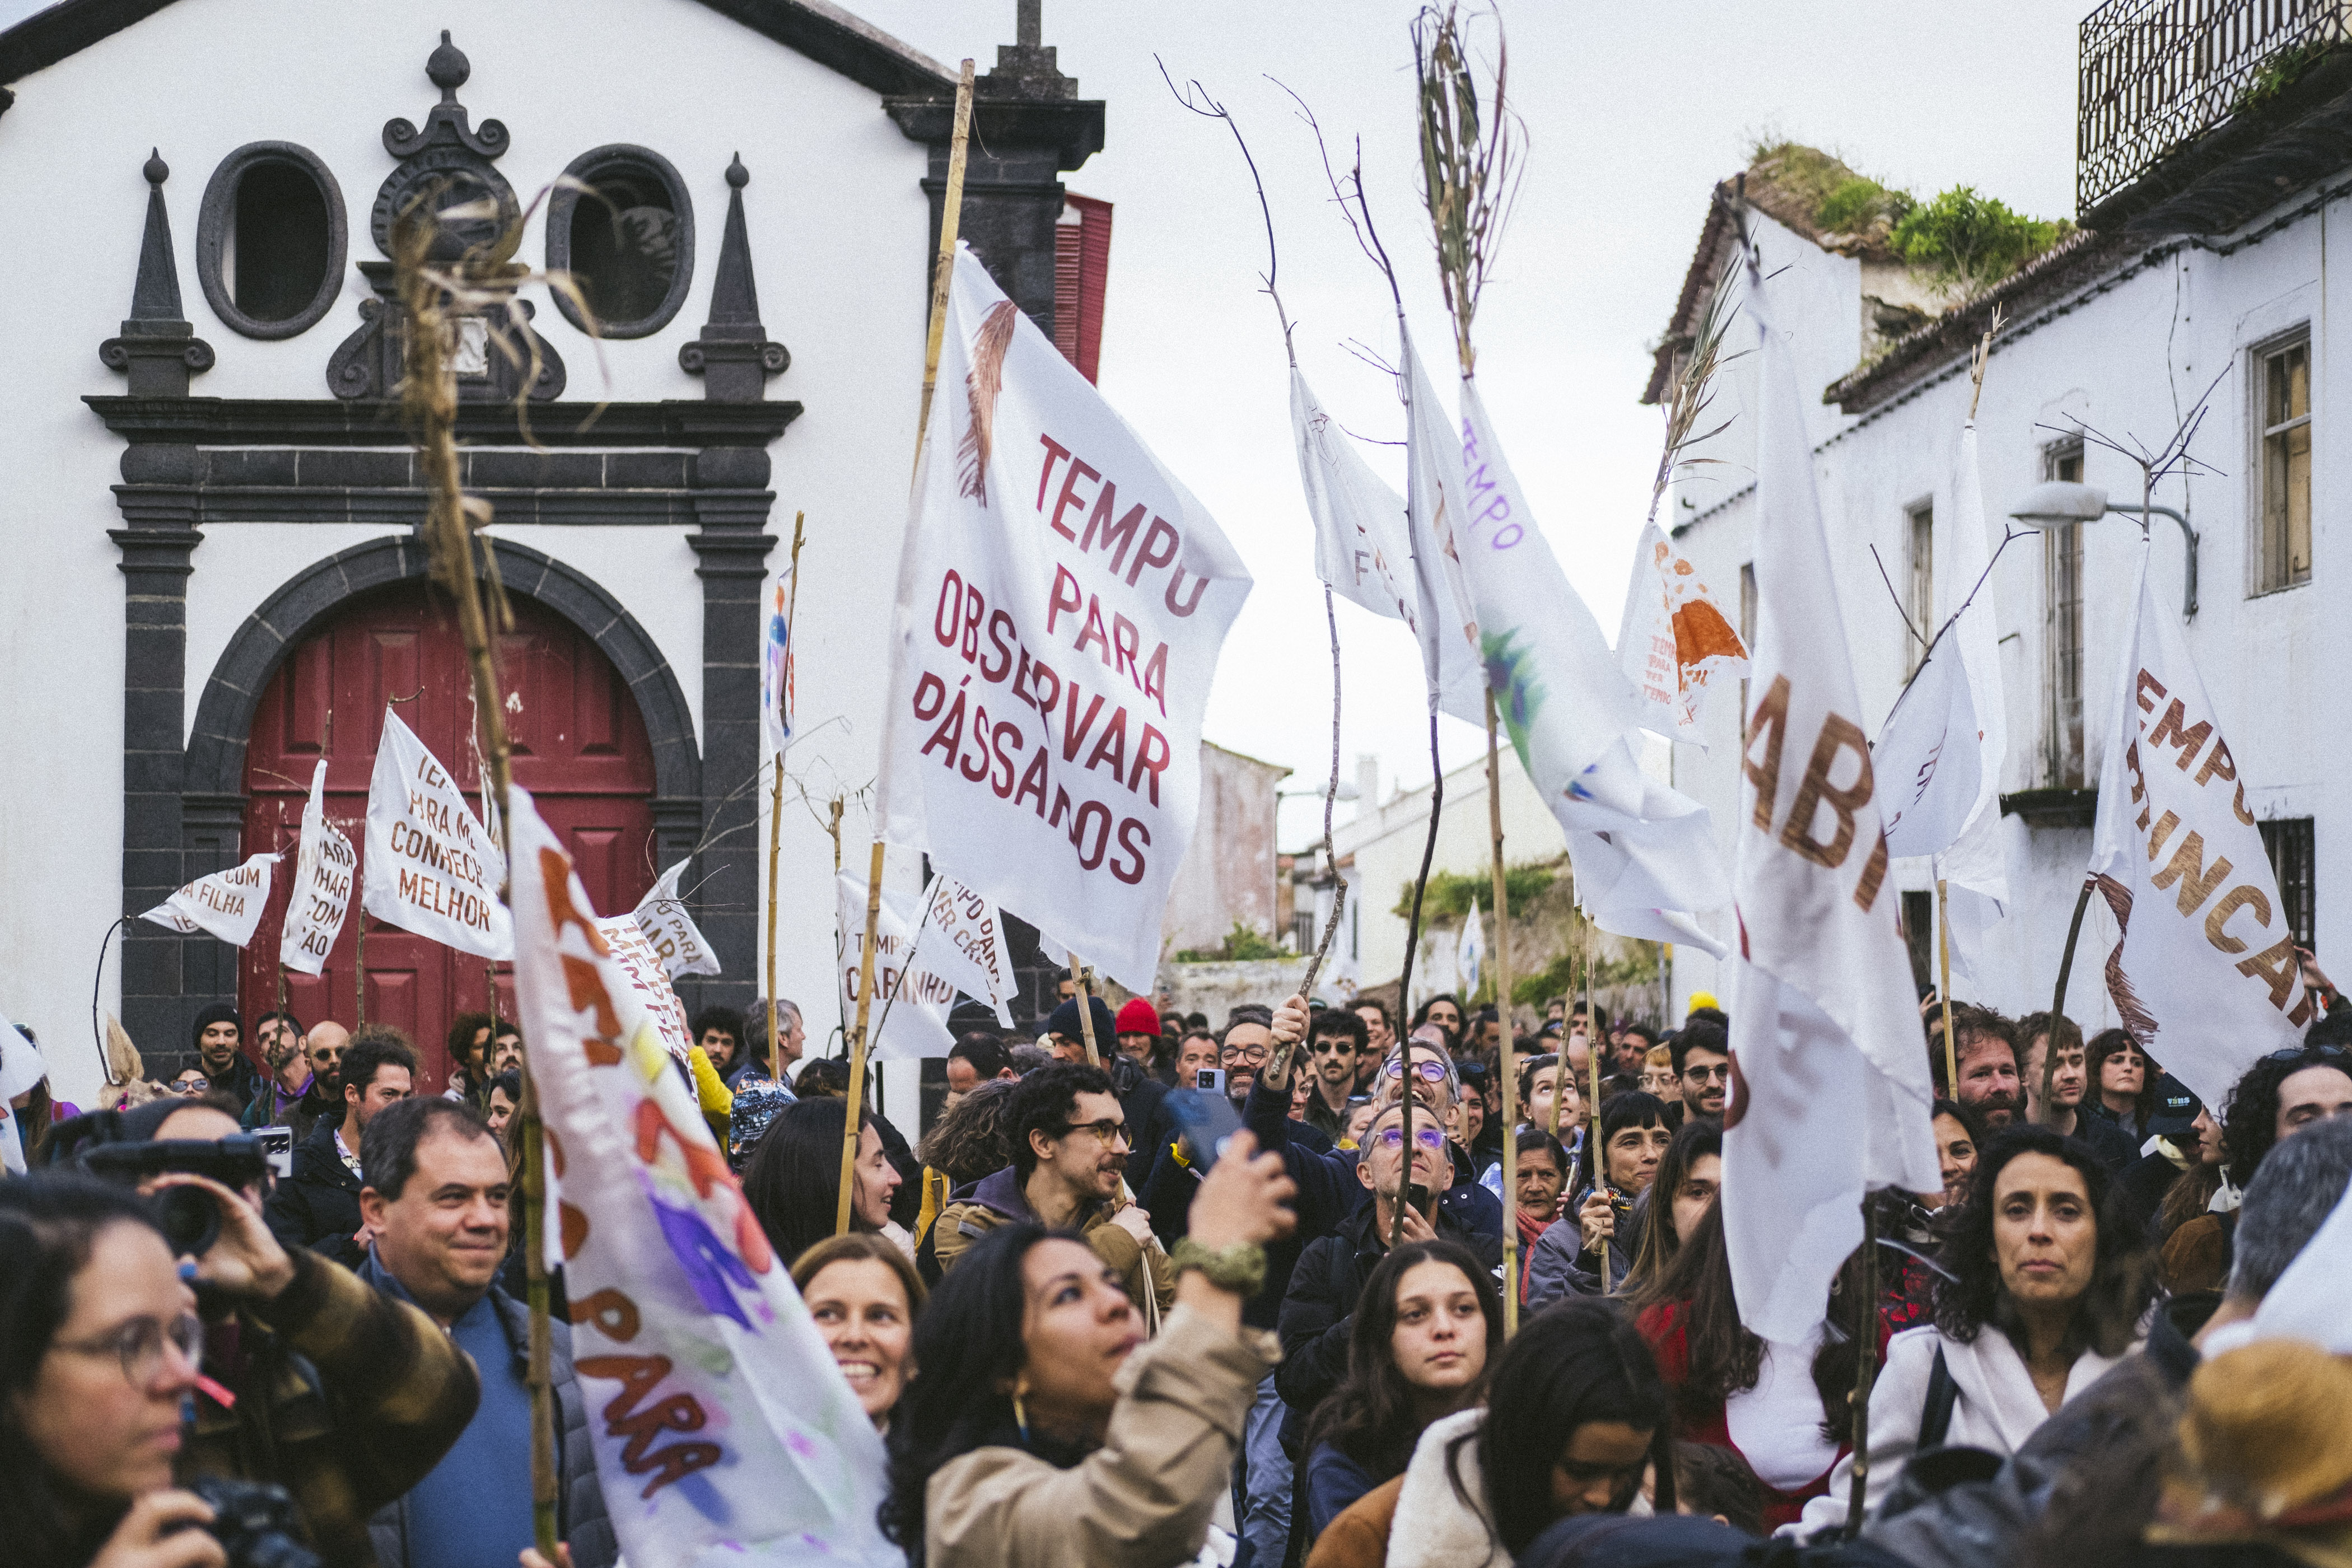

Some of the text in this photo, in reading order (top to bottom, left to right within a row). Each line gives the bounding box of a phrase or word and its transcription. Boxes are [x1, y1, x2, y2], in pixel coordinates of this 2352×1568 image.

[1047, 562, 1167, 719] PARA
[319, 840, 353, 869] ARA
[391, 820, 484, 889] CONHECE
[198, 883, 245, 917] FILHA
[399, 867, 491, 932] MELHOR
[668, 919, 702, 964] PARA
